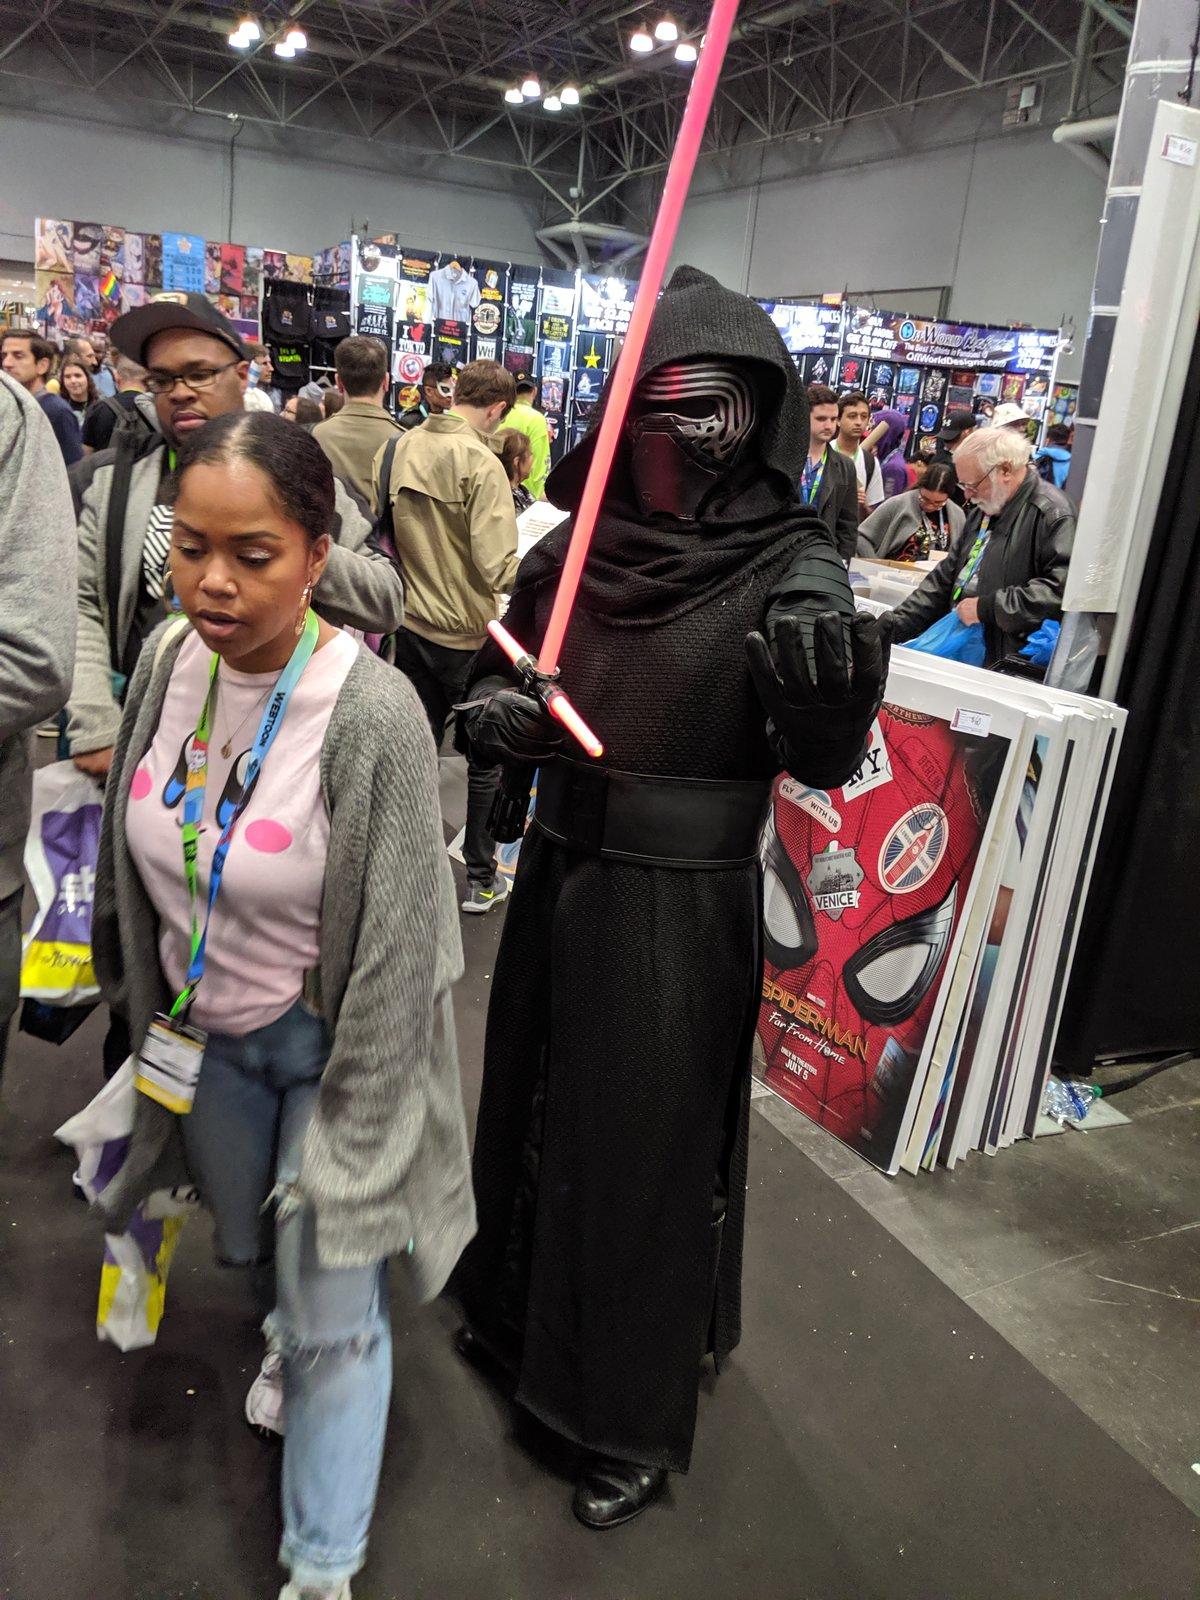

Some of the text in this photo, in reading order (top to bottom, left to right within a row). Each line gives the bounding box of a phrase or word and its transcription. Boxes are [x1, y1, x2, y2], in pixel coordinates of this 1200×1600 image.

[403, 324, 410, 339] I
[398, 338, 426, 355] TOKYO
[477, 345, 495, 358] Wtf
[906, 352, 1008, 368] OffWorldDesigns.com
[259, 691, 286, 747] WEBTOON
[782, 783, 795, 795] FLY
[810, 801, 839, 828] WITH US
[815, 892, 854, 909] VENICE
[768, 1011, 786, 1028] Far
[786, 1022, 812, 1046] From
[785, 1058, 809, 1081] JULY 5
